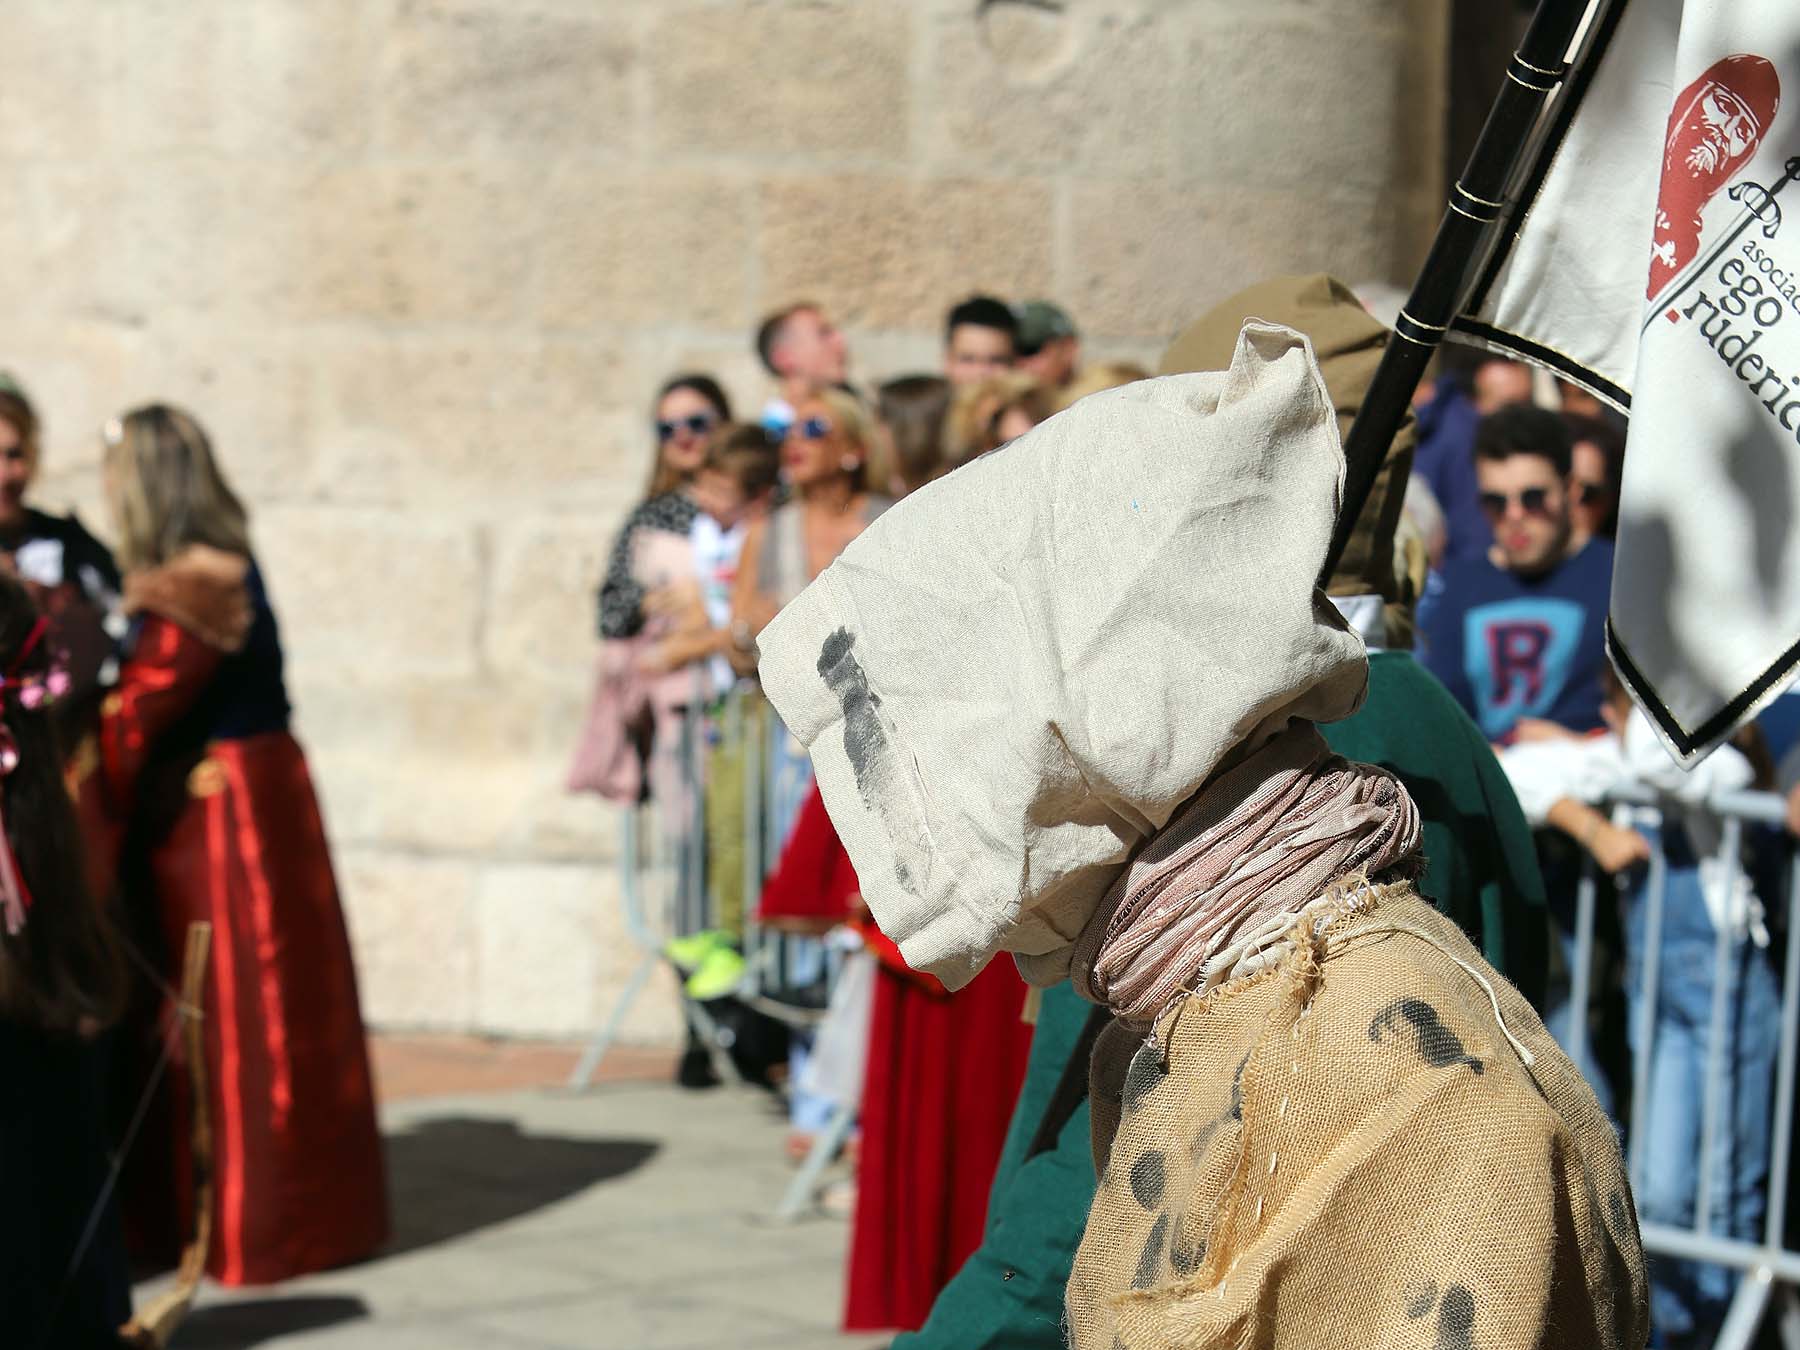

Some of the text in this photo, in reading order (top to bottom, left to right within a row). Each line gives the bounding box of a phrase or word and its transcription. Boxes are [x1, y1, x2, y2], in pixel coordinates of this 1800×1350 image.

[1719, 258, 1783, 327] ego
[1682, 290, 1800, 446] ruderic
[1487, 620, 1553, 708] R
